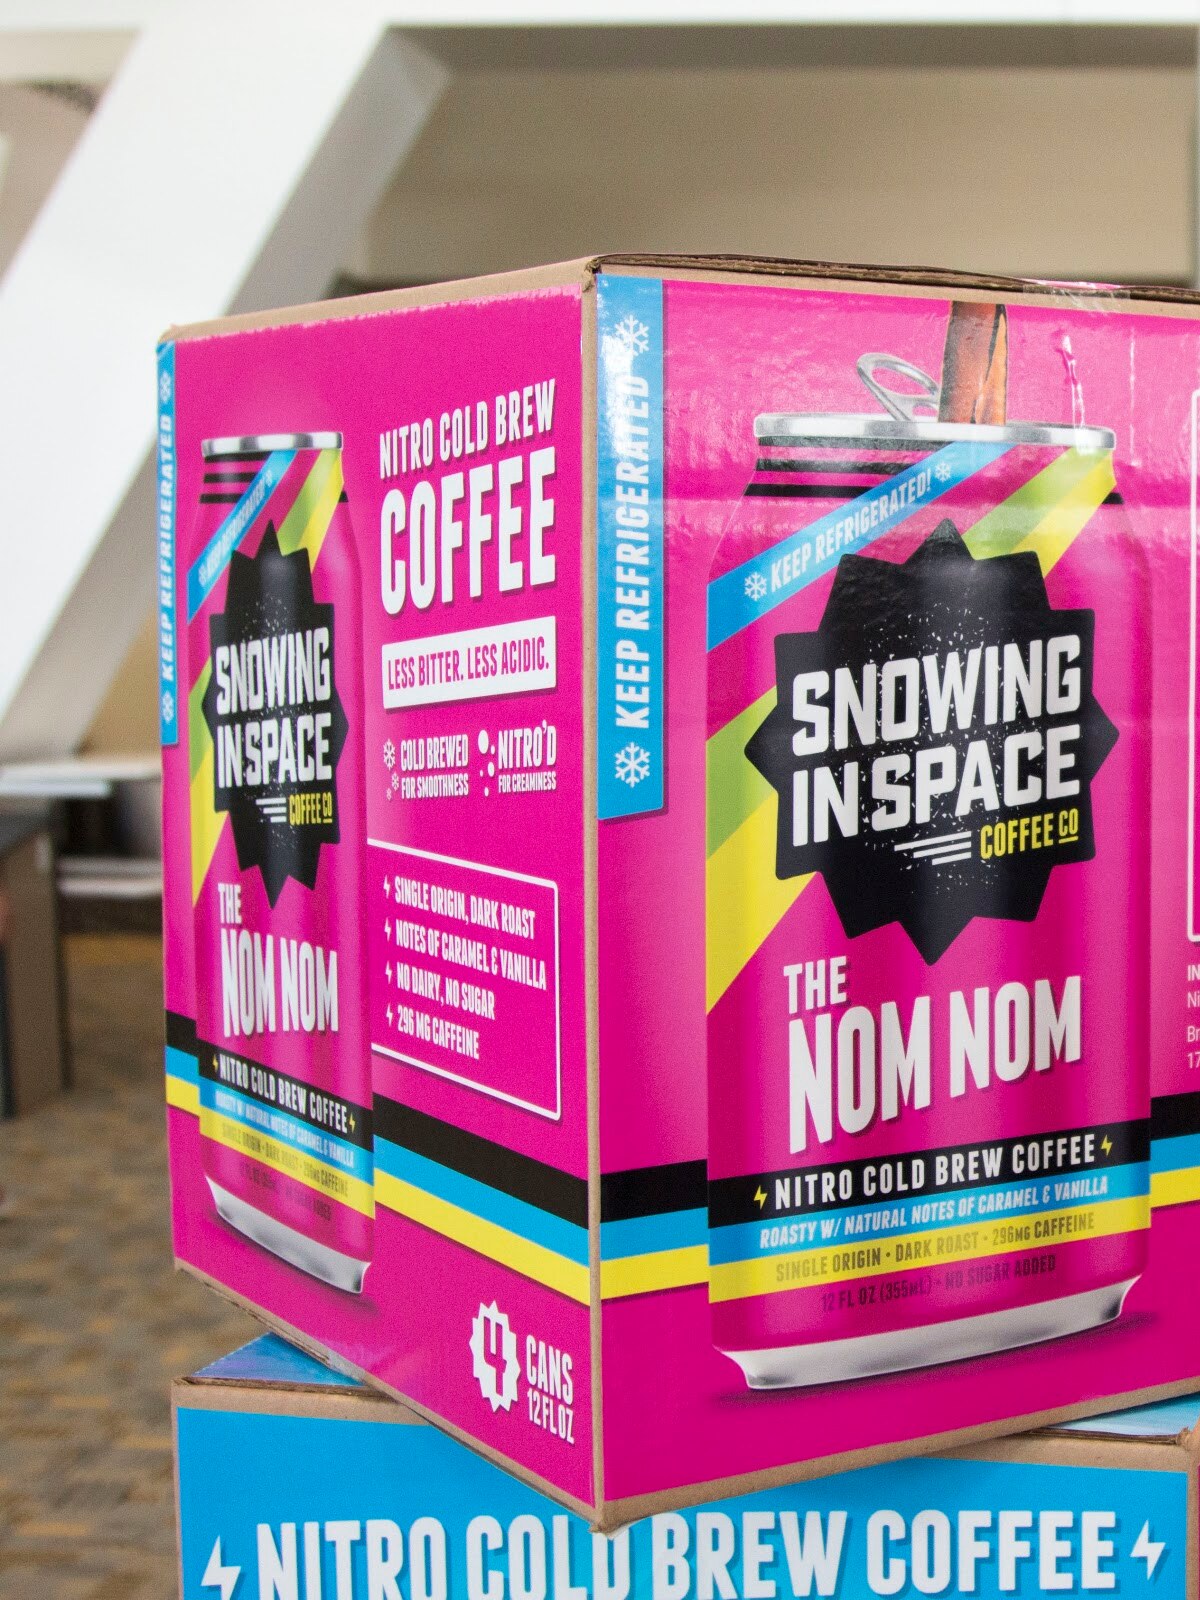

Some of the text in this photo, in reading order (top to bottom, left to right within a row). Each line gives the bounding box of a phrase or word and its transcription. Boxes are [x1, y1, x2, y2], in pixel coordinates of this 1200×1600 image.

[380, 378, 556, 479] NITRO COLD BREW
[160, 414, 175, 682] KEEP REFRIGERATED
[380, 446, 556, 615] COFFEE
[615, 375, 650, 729] KEEP REFRIGERATED
[771, 467, 931, 593] KEEP REFRIGERATED!
[215, 626, 331, 715] SNOWING
[388, 636, 550, 691] LESS BITTER. LESS ACIDIC.
[792, 633, 1081, 757] SNOWING
[217, 712, 332, 789] IN SPACE
[400, 734, 469, 772] COLD BREWED
[498, 719, 557, 769] NITRO'D
[289, 793, 322, 825] COFFEE
[401, 773, 469, 799] FOR SMOOTHNESS
[498, 771, 557, 793] FOR CREAMINESS
[792, 724, 1081, 847] IN SPACE
[980, 812, 1055, 861] COFFEE
[217, 883, 242, 924] THE
[394, 876, 535, 940] SINGLE ORIGIN, DARK ROAST
[220, 927, 339, 1038] NOM NOM
[396, 918, 547, 991] NOTES OF CARAMEL VANILLA
[396, 961, 495, 1020] NO DAIRY, NO SUGAR
[783, 955, 848, 1015] THE
[397, 1004, 480, 1060] 296 MG CAFFEINE
[788, 975, 1082, 1155] NOM NOM
[219, 1053, 249, 1090] NITRO
[250, 1067, 276, 1101] COLD
[278, 1078, 307, 1116] BREW
[309, 1091, 348, 1134] COFFEE
[775, 1133, 1096, 1211] NITRO COLD BREW COFFEE
[760, 1175, 1108, 1249] ROASTY NATURAL NOTES OF CARAMEL VANILLA
[776, 1211, 1095, 1282] SINGLE ORIGIN DARK ROAST CAFFEINE
[526, 1334, 573, 1406] CANS
[257, 1516, 447, 1600] NITRO
[466, 1514, 631, 1600] COLD
[652, 1510, 847, 1600] BREW
[866, 1509, 1116, 1594] COFFEE
